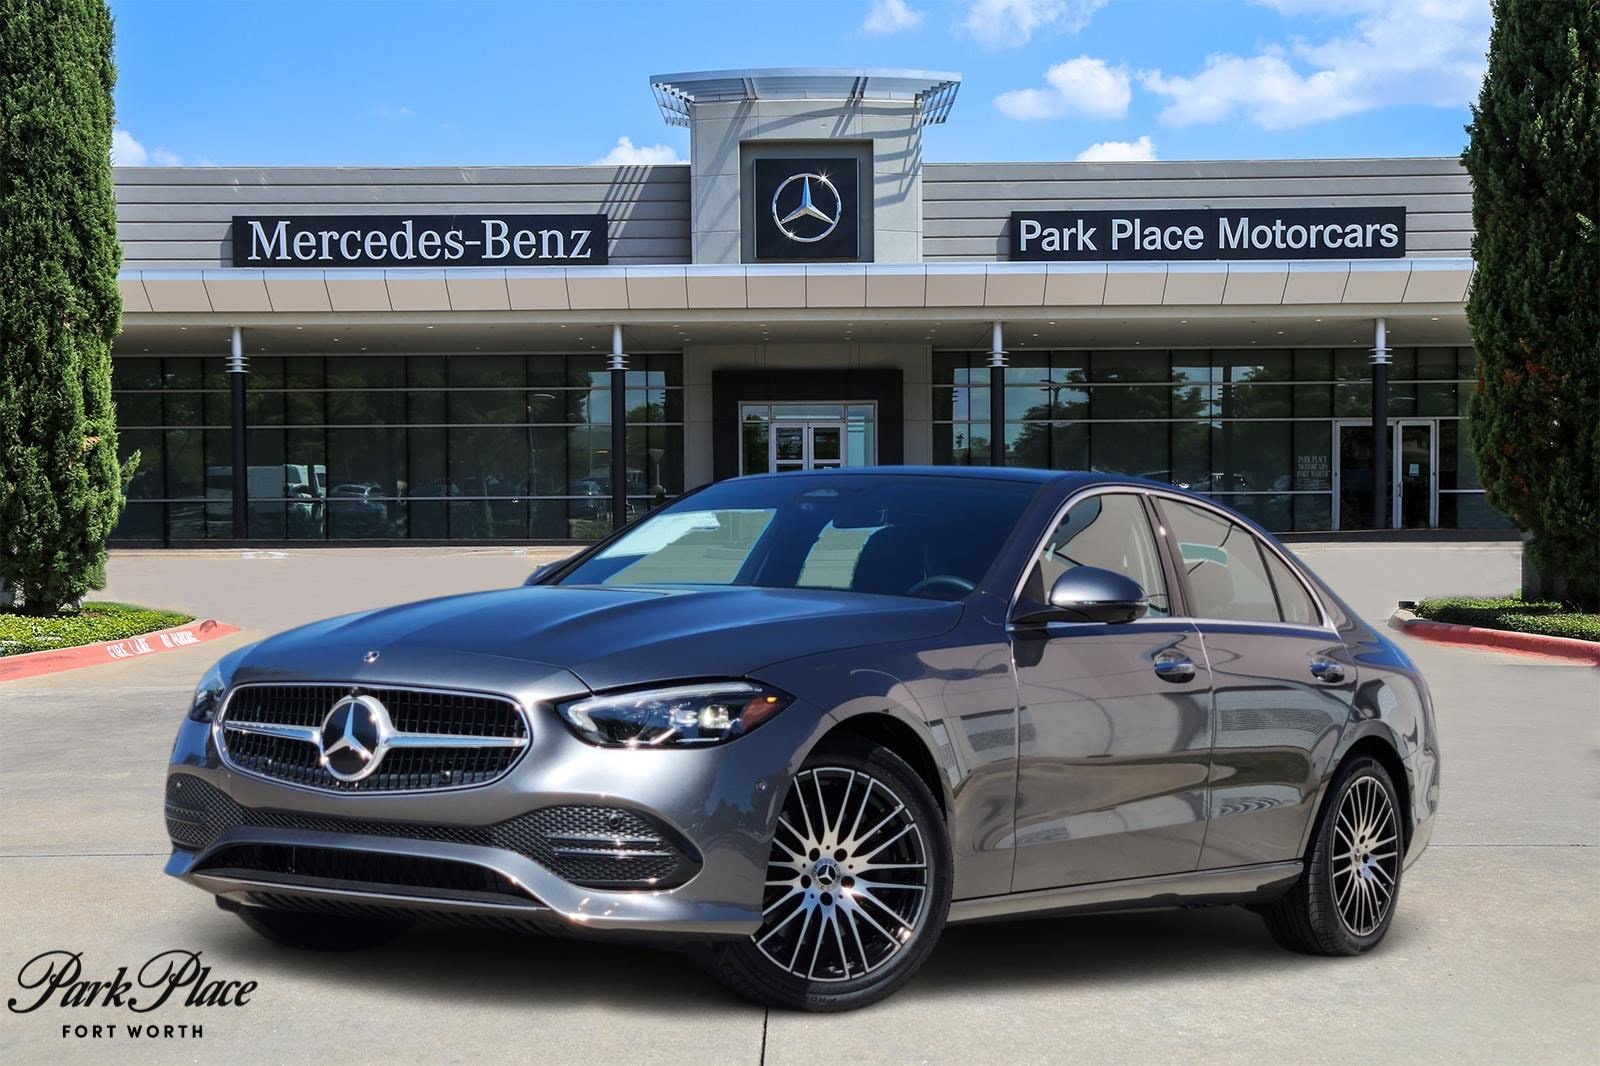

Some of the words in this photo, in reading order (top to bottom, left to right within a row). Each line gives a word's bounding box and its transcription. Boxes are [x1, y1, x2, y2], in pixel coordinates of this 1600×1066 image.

[247, 218, 592, 261] Mercedes-Benz
[1019, 219, 1097, 252] Park
[1111, 218, 1204, 251] Place
[1218, 216, 1399, 250] Motorcars
